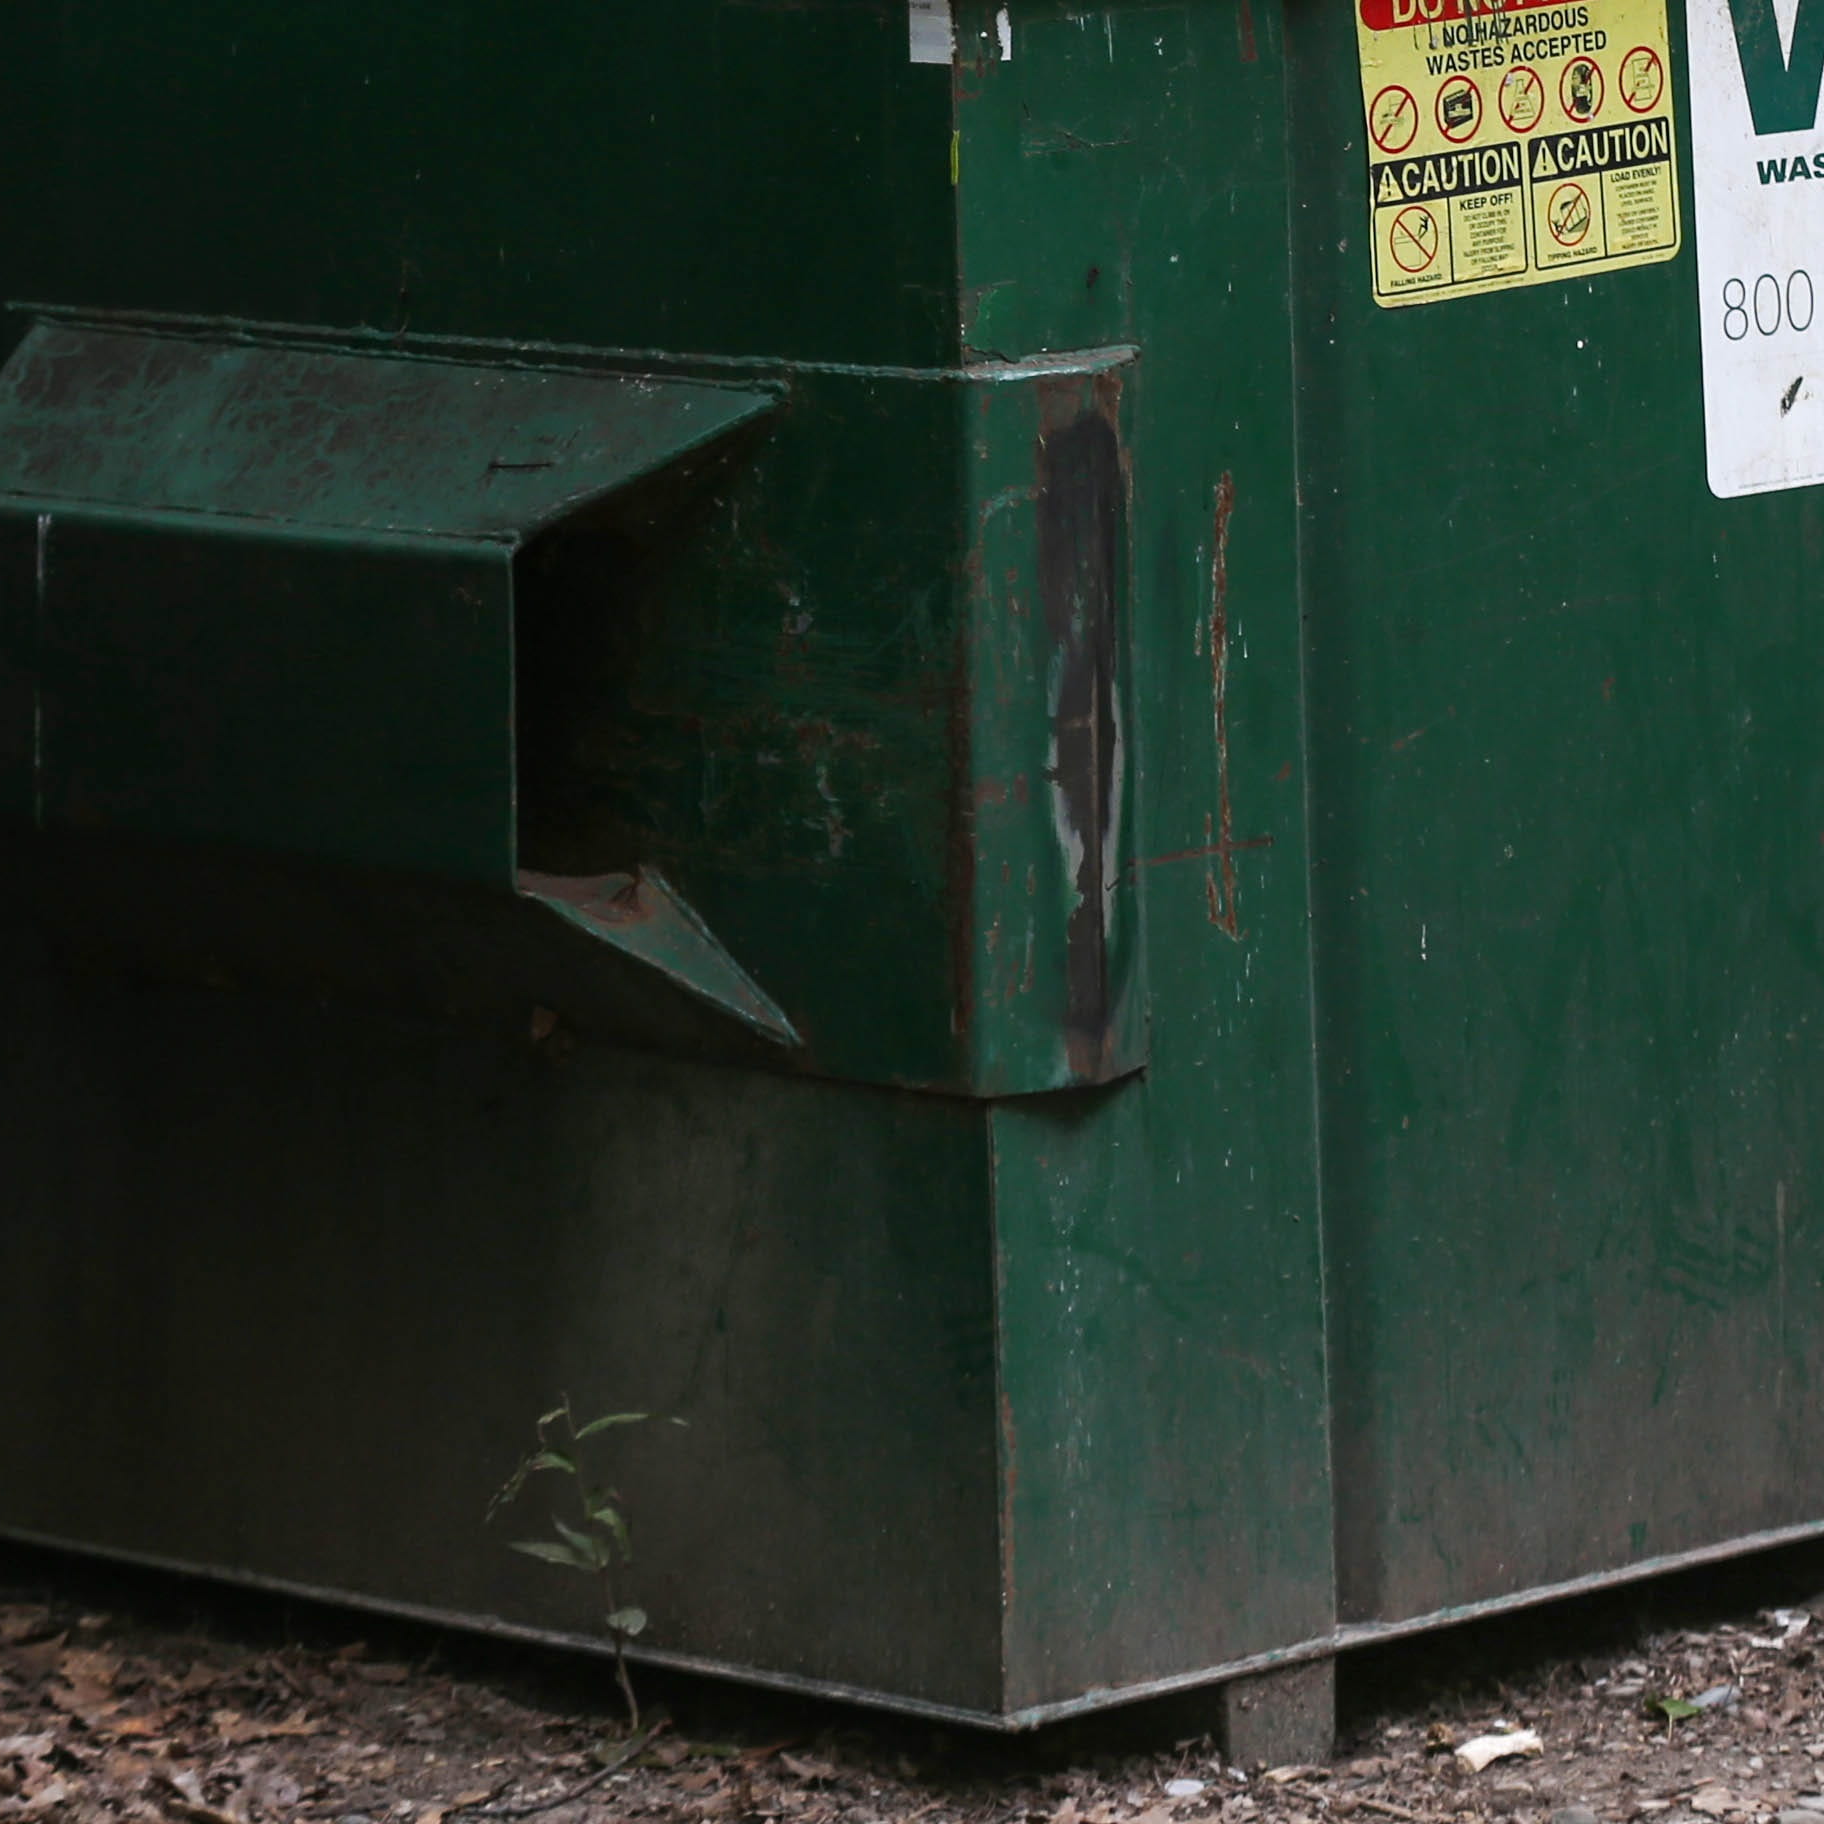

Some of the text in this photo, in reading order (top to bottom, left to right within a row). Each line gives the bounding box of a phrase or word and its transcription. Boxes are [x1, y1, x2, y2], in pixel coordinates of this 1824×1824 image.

[1442, 7, 1589, 47] NO HAZARDOUS
[1426, 30, 1607, 75] WASTES ACCEPTED
[1556, 121, 1669, 172] CAUTION
[1401, 146, 1520, 197] CAUTION
[1610, 171, 1631, 183] LOAD
[1459, 193, 1513, 211] KEEP OFF!
[1547, 246, 1597, 262] TIPPING HAZARD
[1390, 273, 1442, 288] FALLING HAZARD
[1723, 269, 1814, 342] 800
